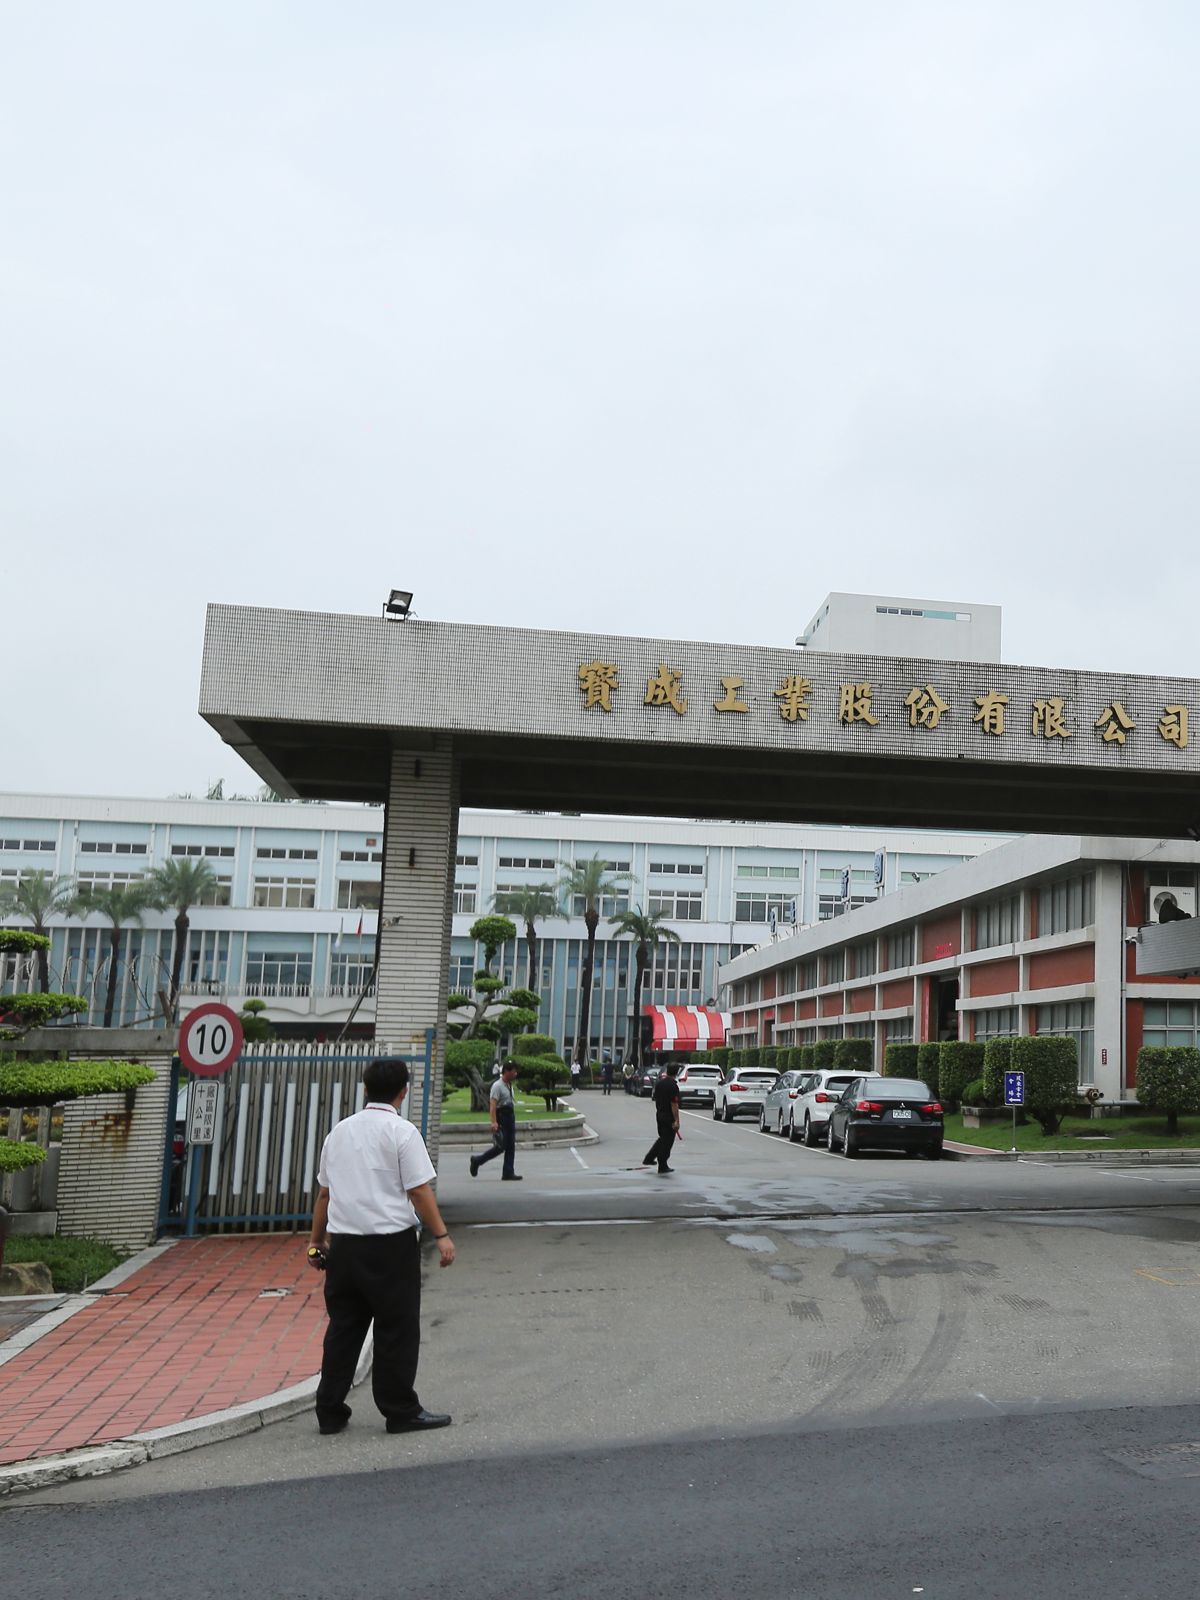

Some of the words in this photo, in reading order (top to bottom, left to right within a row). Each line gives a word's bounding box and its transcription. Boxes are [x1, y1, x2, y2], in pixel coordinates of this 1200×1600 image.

[578, 660, 1189, 748] 寶成工業股份有限公司
[196, 1023, 227, 1055] 10
[193, 1084, 206, 1140] 十公里
